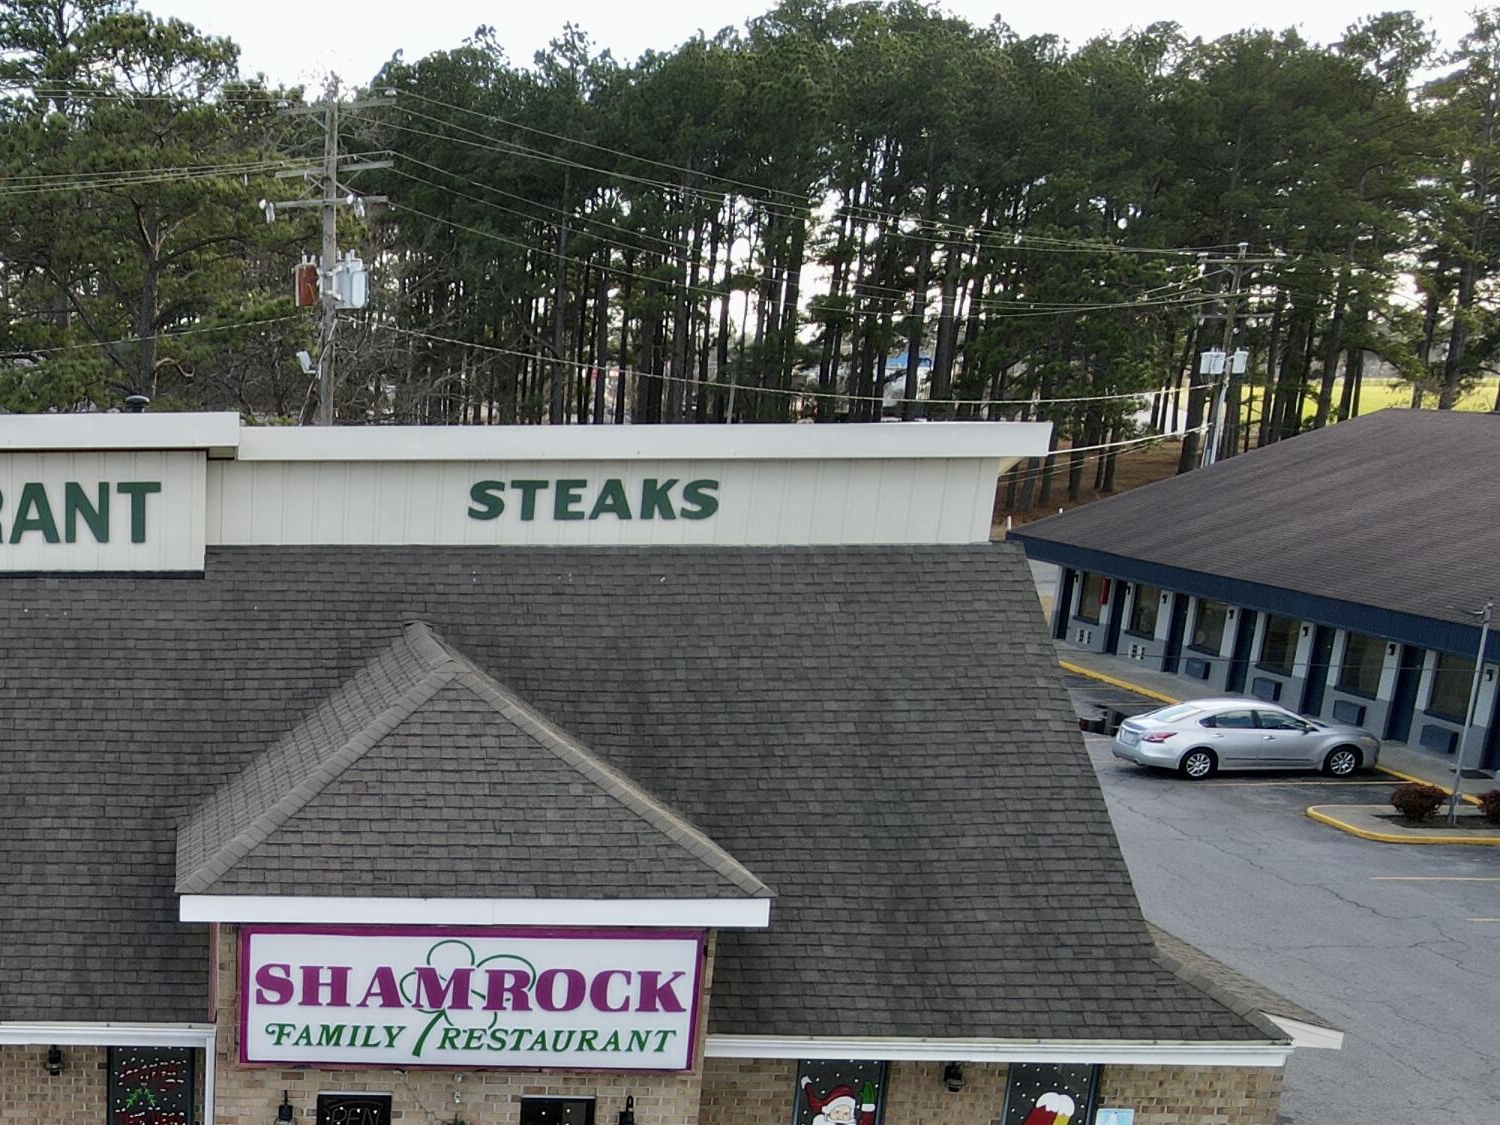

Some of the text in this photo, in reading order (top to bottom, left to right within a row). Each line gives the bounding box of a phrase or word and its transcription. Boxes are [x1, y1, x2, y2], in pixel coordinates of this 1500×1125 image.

[467, 479, 720, 521] STEAKS
[254, 962, 687, 1013] SHAMROCK
[265, 1022, 677, 1053] FAMILY RESTAURANT
